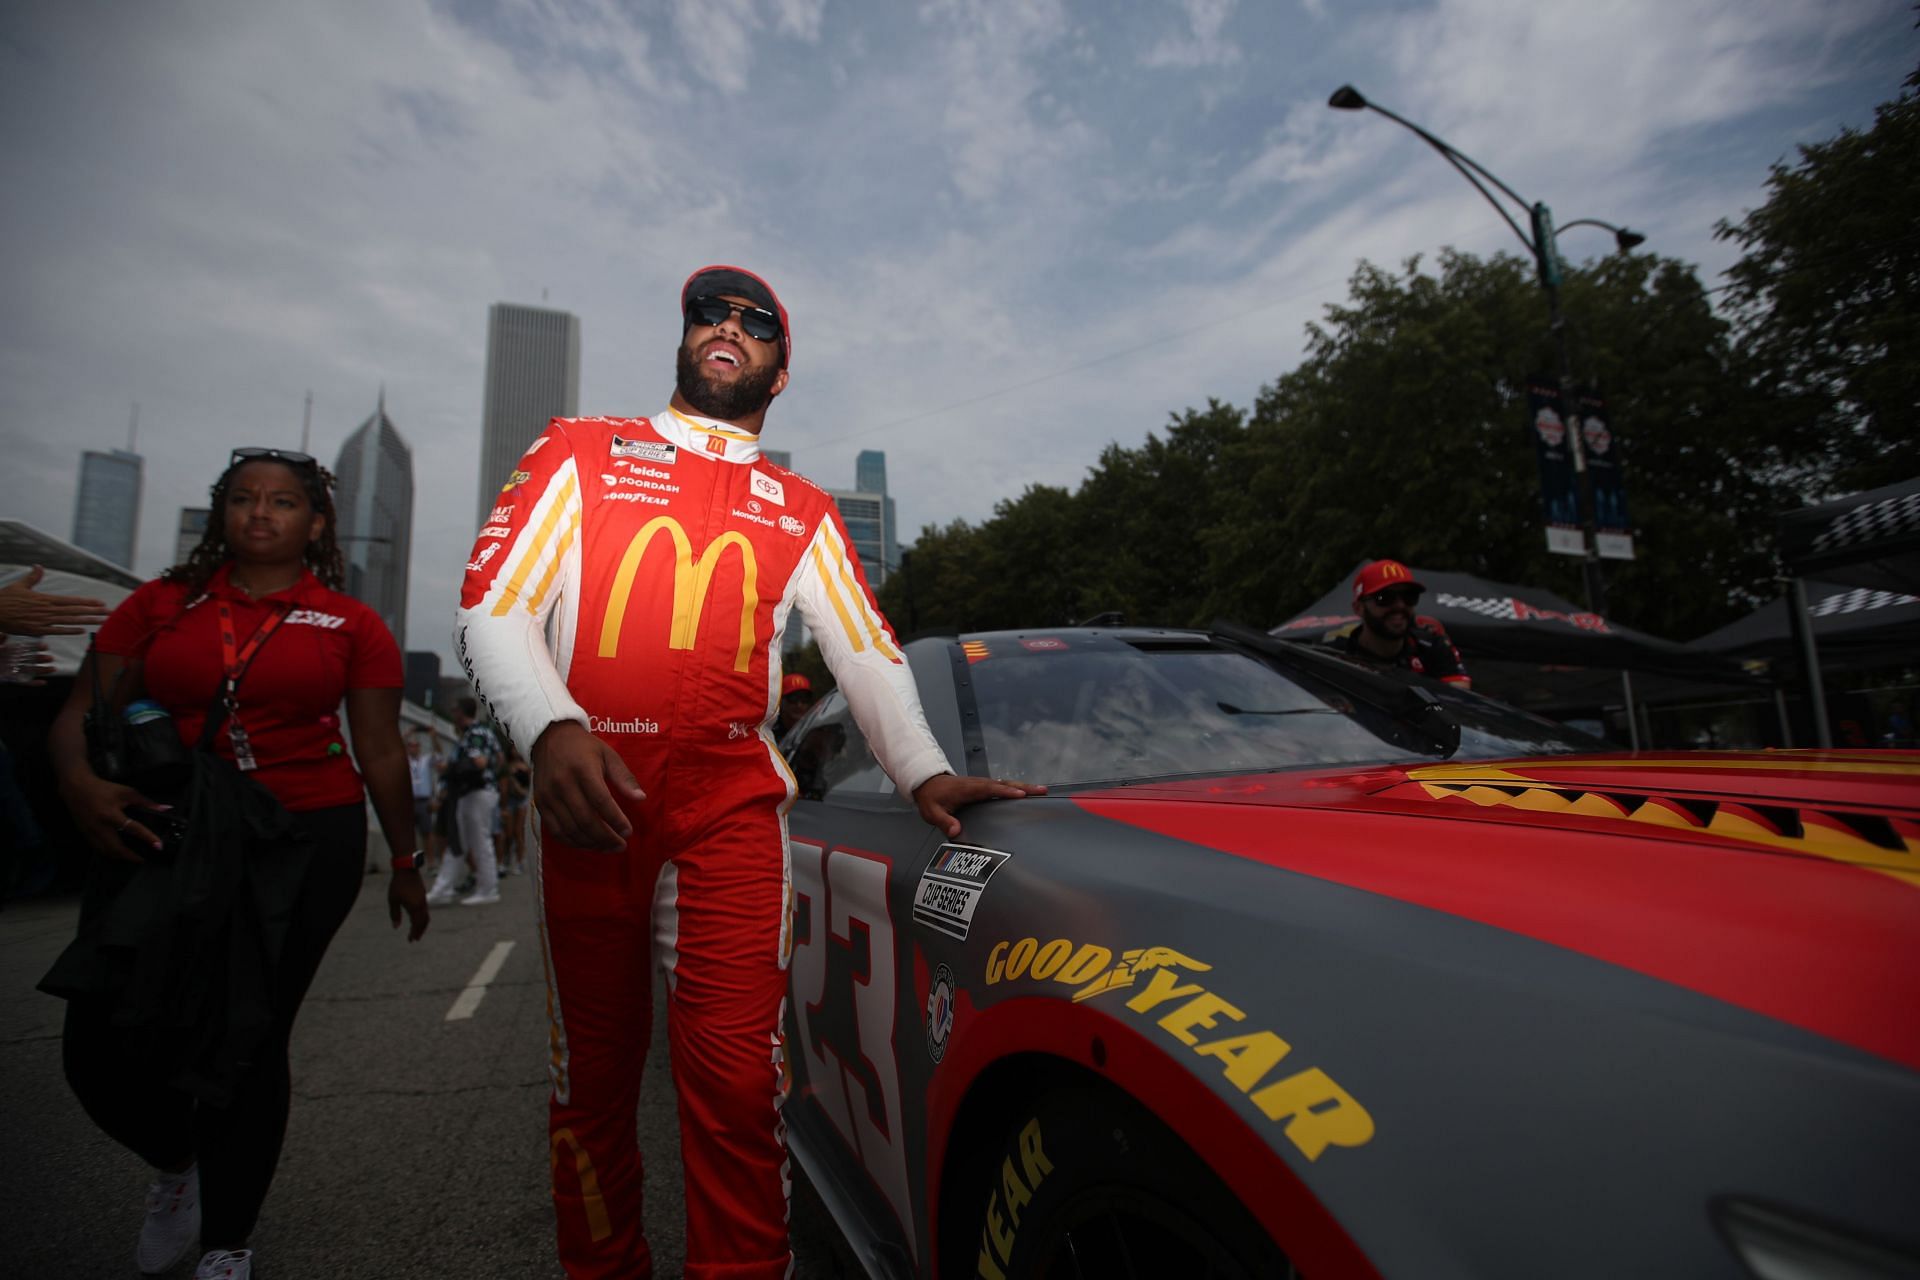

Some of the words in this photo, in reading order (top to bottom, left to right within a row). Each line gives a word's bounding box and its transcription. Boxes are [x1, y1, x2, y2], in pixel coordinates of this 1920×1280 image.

[629, 464, 672, 480] leidos
[618, 476, 681, 494] DOORDASH
[603, 492, 671, 507] GOODYEAR
[732, 509, 775, 527] MoneyLion
[588, 715, 659, 733] Columbia
[944, 850, 993, 877] NASCAR
[922, 882, 942, 906] CUP
[937, 885, 971, 915] SERIES
[985, 937, 1375, 1163] GOODYEAR
